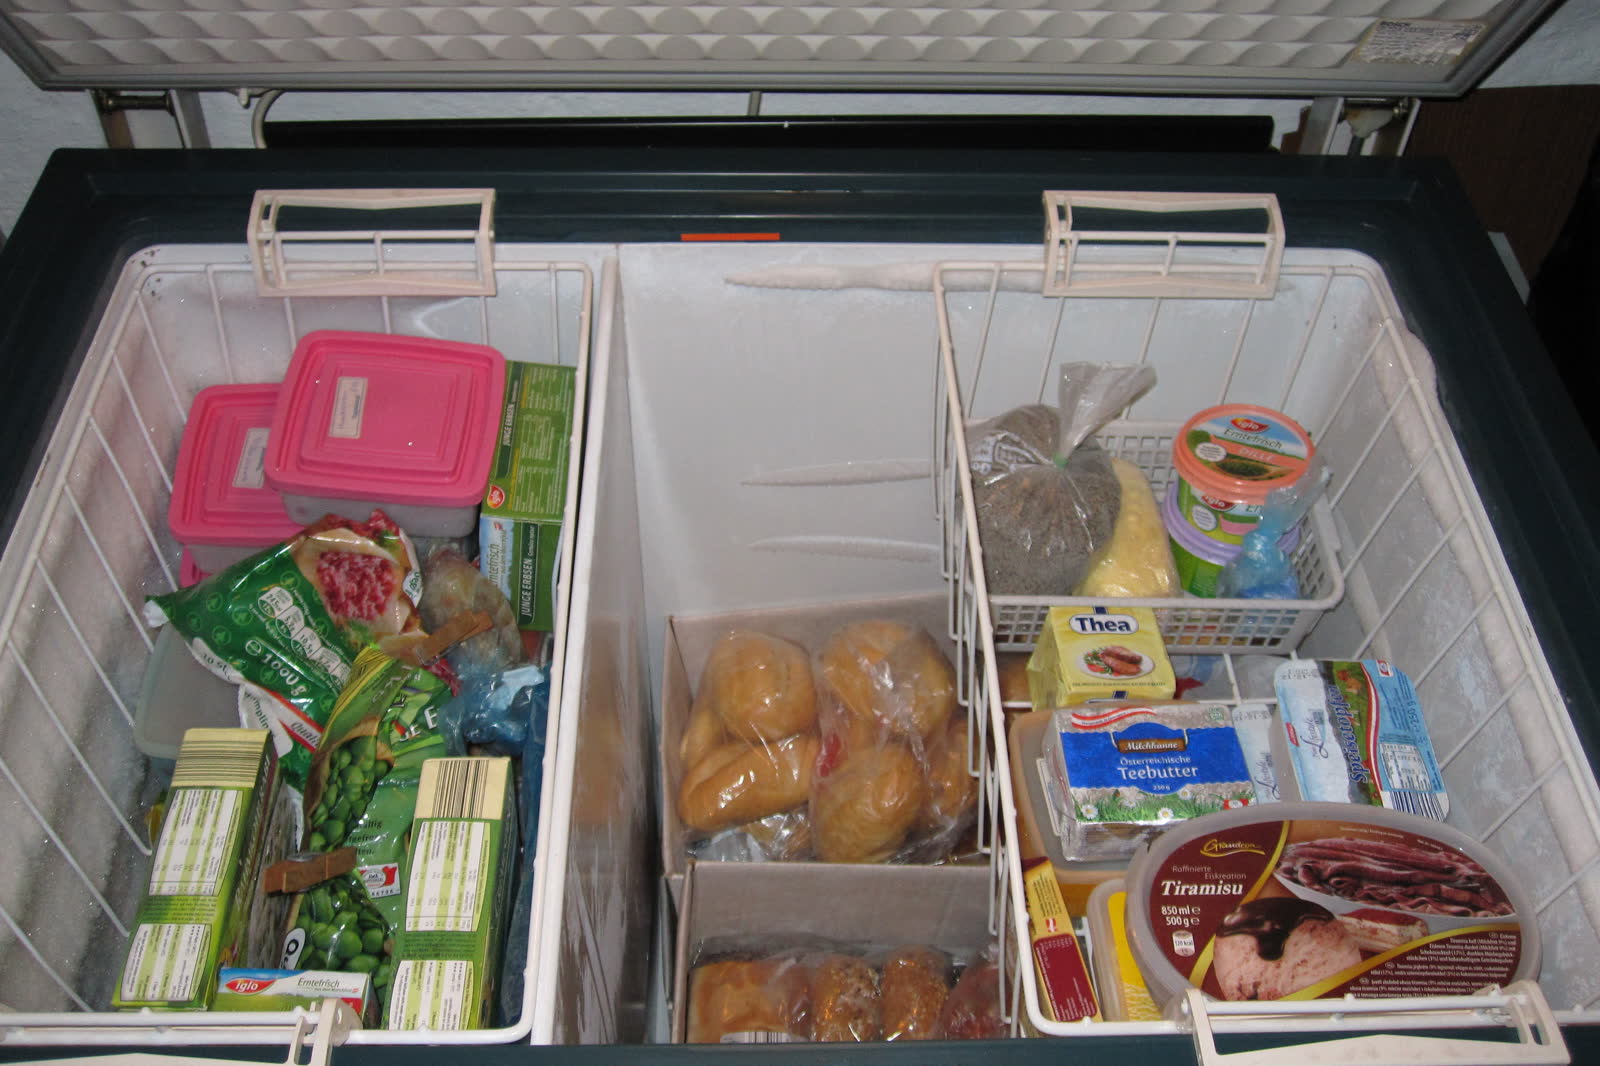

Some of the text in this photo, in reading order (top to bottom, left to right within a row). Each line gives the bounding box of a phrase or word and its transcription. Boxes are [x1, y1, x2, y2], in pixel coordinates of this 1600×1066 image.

[1223, 428, 1283, 449] Erntefrisch
[522, 558, 532, 589] ERBSEN
[520, 590, 532, 616] JUNGE
[1075, 617, 1132, 632] Thea
[1327, 684, 1370, 783] Speisetopfen
[1120, 756, 1191, 765] Österreichische
[1117, 765, 1198, 780] Teebutter
[1161, 880, 1243, 896] Tiramisu
[1161, 906, 1178, 915] 850
[1179, 905, 1190, 915] ml
[1166, 917, 1182, 926] 500
[1184, 918, 1190, 928] g
[235, 979, 259, 993] iglo
[298, 978, 340, 988] Erntefrisch
